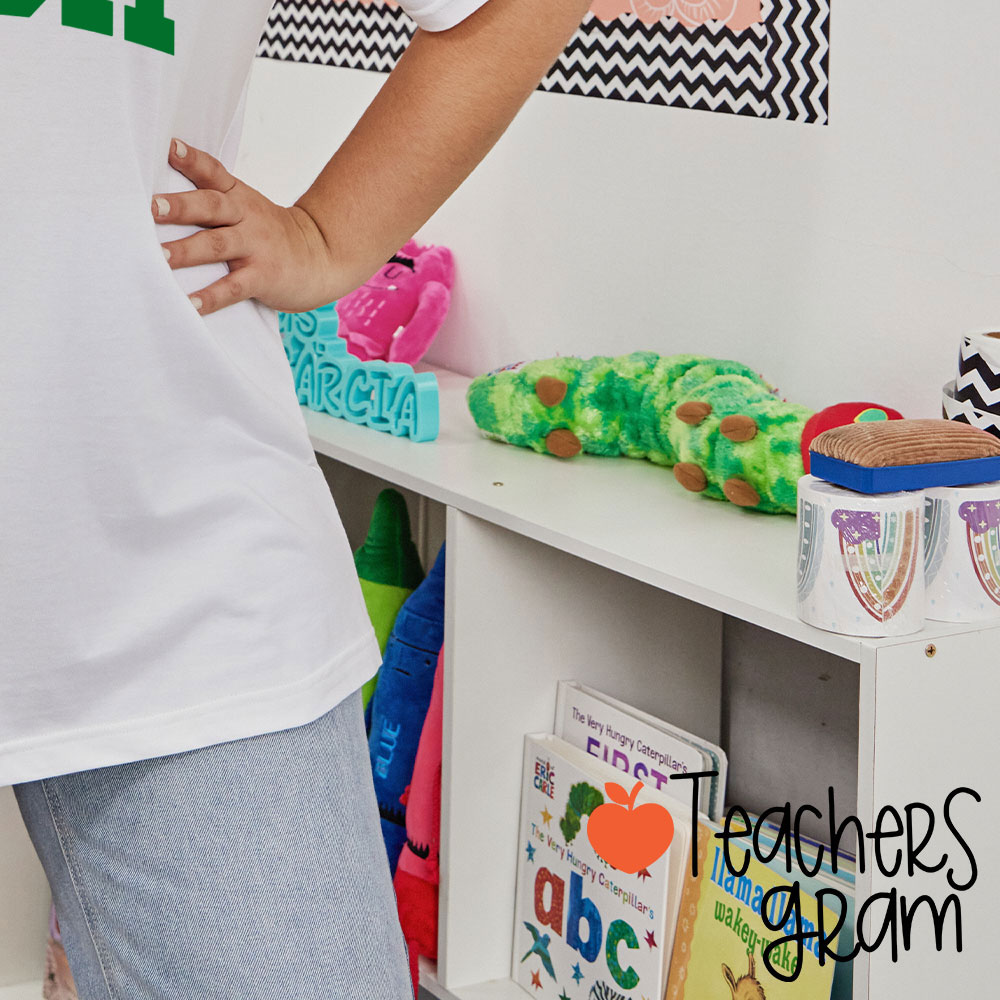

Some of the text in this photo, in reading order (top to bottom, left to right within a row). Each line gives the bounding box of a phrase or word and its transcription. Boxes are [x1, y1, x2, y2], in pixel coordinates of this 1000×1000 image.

[374, 713, 401, 780] BLUE
[534, 760, 556, 786] ERIC
[571, 706, 688, 774] The Very Hungry Caterpillar's
[533, 775, 555, 801] CARLE
[531, 823, 655, 920] The Very Hungry Caterpillar's
[534, 866, 640, 990] abc
